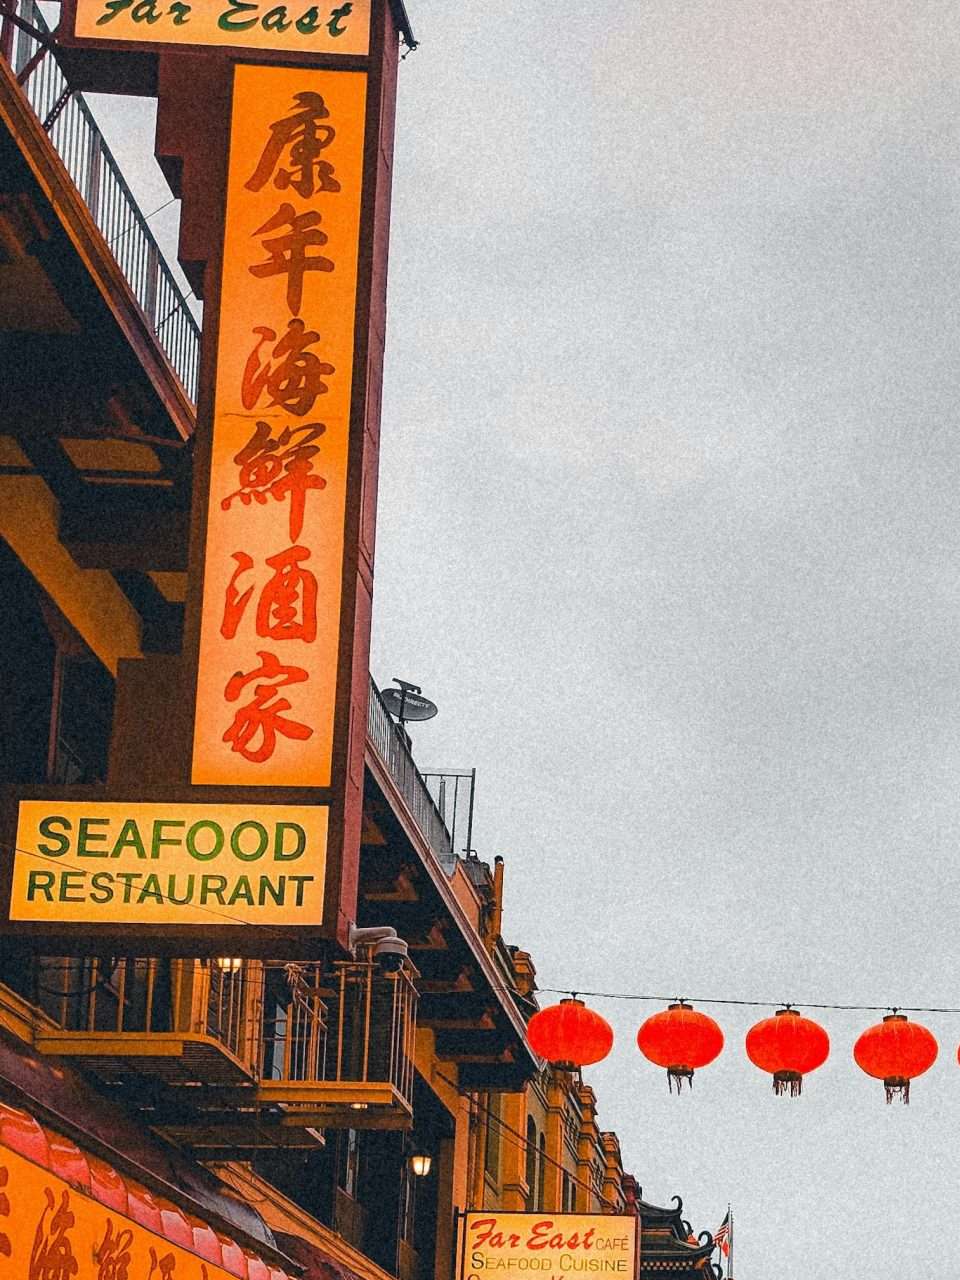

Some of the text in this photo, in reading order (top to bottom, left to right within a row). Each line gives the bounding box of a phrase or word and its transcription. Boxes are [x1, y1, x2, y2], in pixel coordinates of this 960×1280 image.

[217, 0, 353, 37] East
[219, 91, 341, 764] 康年海鮮酒家
[37, 815, 307, 862] SEAFOOD
[26, 870, 315, 907] RESTAURANT
[470, 1218, 630, 1251] Far East CAFÉ
[471, 1251, 628, 1272] SEAFOOD CUISINE
